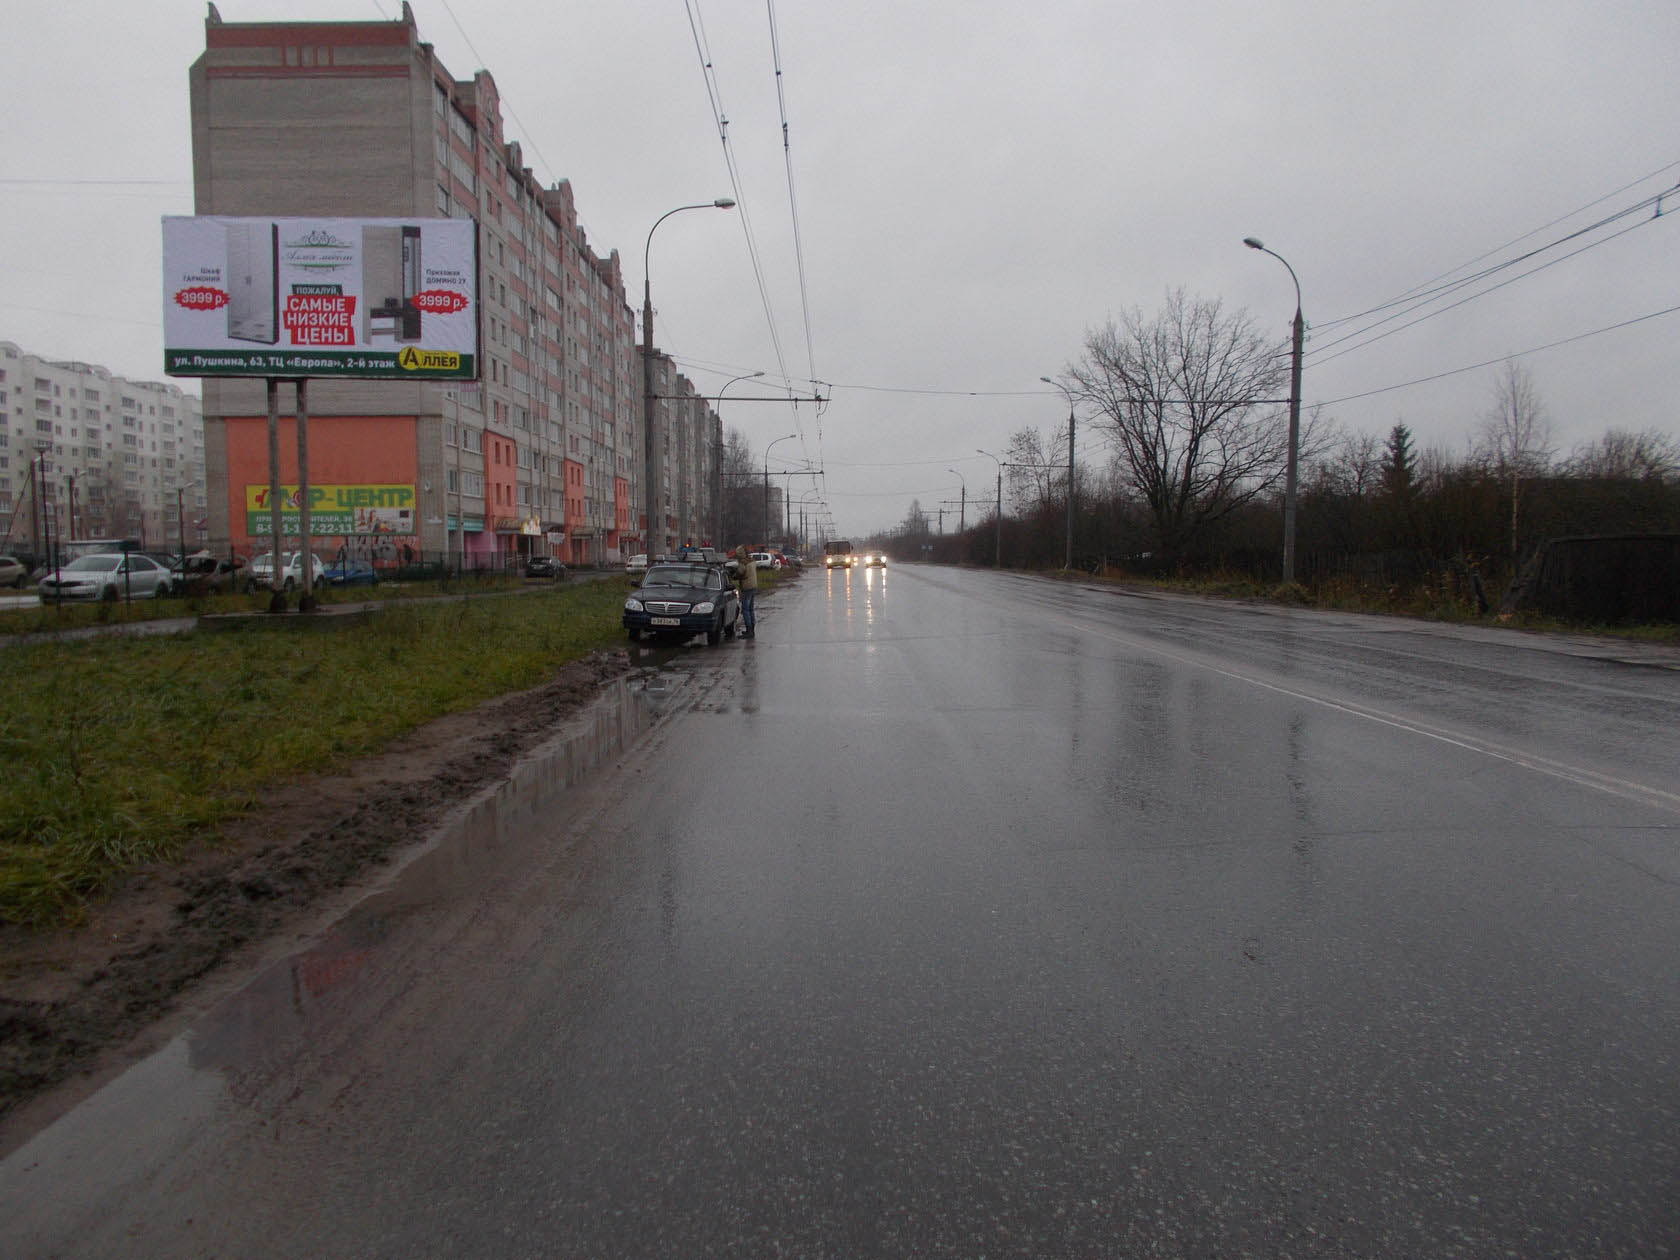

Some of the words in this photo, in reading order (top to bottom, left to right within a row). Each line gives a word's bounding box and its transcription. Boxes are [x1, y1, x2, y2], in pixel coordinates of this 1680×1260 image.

[181, 292, 213, 303] 3999
[420, 295, 451, 306] 3999
[290, 298, 346, 312] САМЫЕ
[287, 312, 348, 326] НИЗКИЕ
[297, 328, 348, 344] ЦЕНЫ
[174, 357, 191, 367] ул.
[194, 356, 247, 367] Пушкина,
[249, 357, 266, 367] 63,
[268, 357, 284, 368] ТЦ
[347, 358, 365, 368] 2-й
[368, 359, 395, 368] этаж
